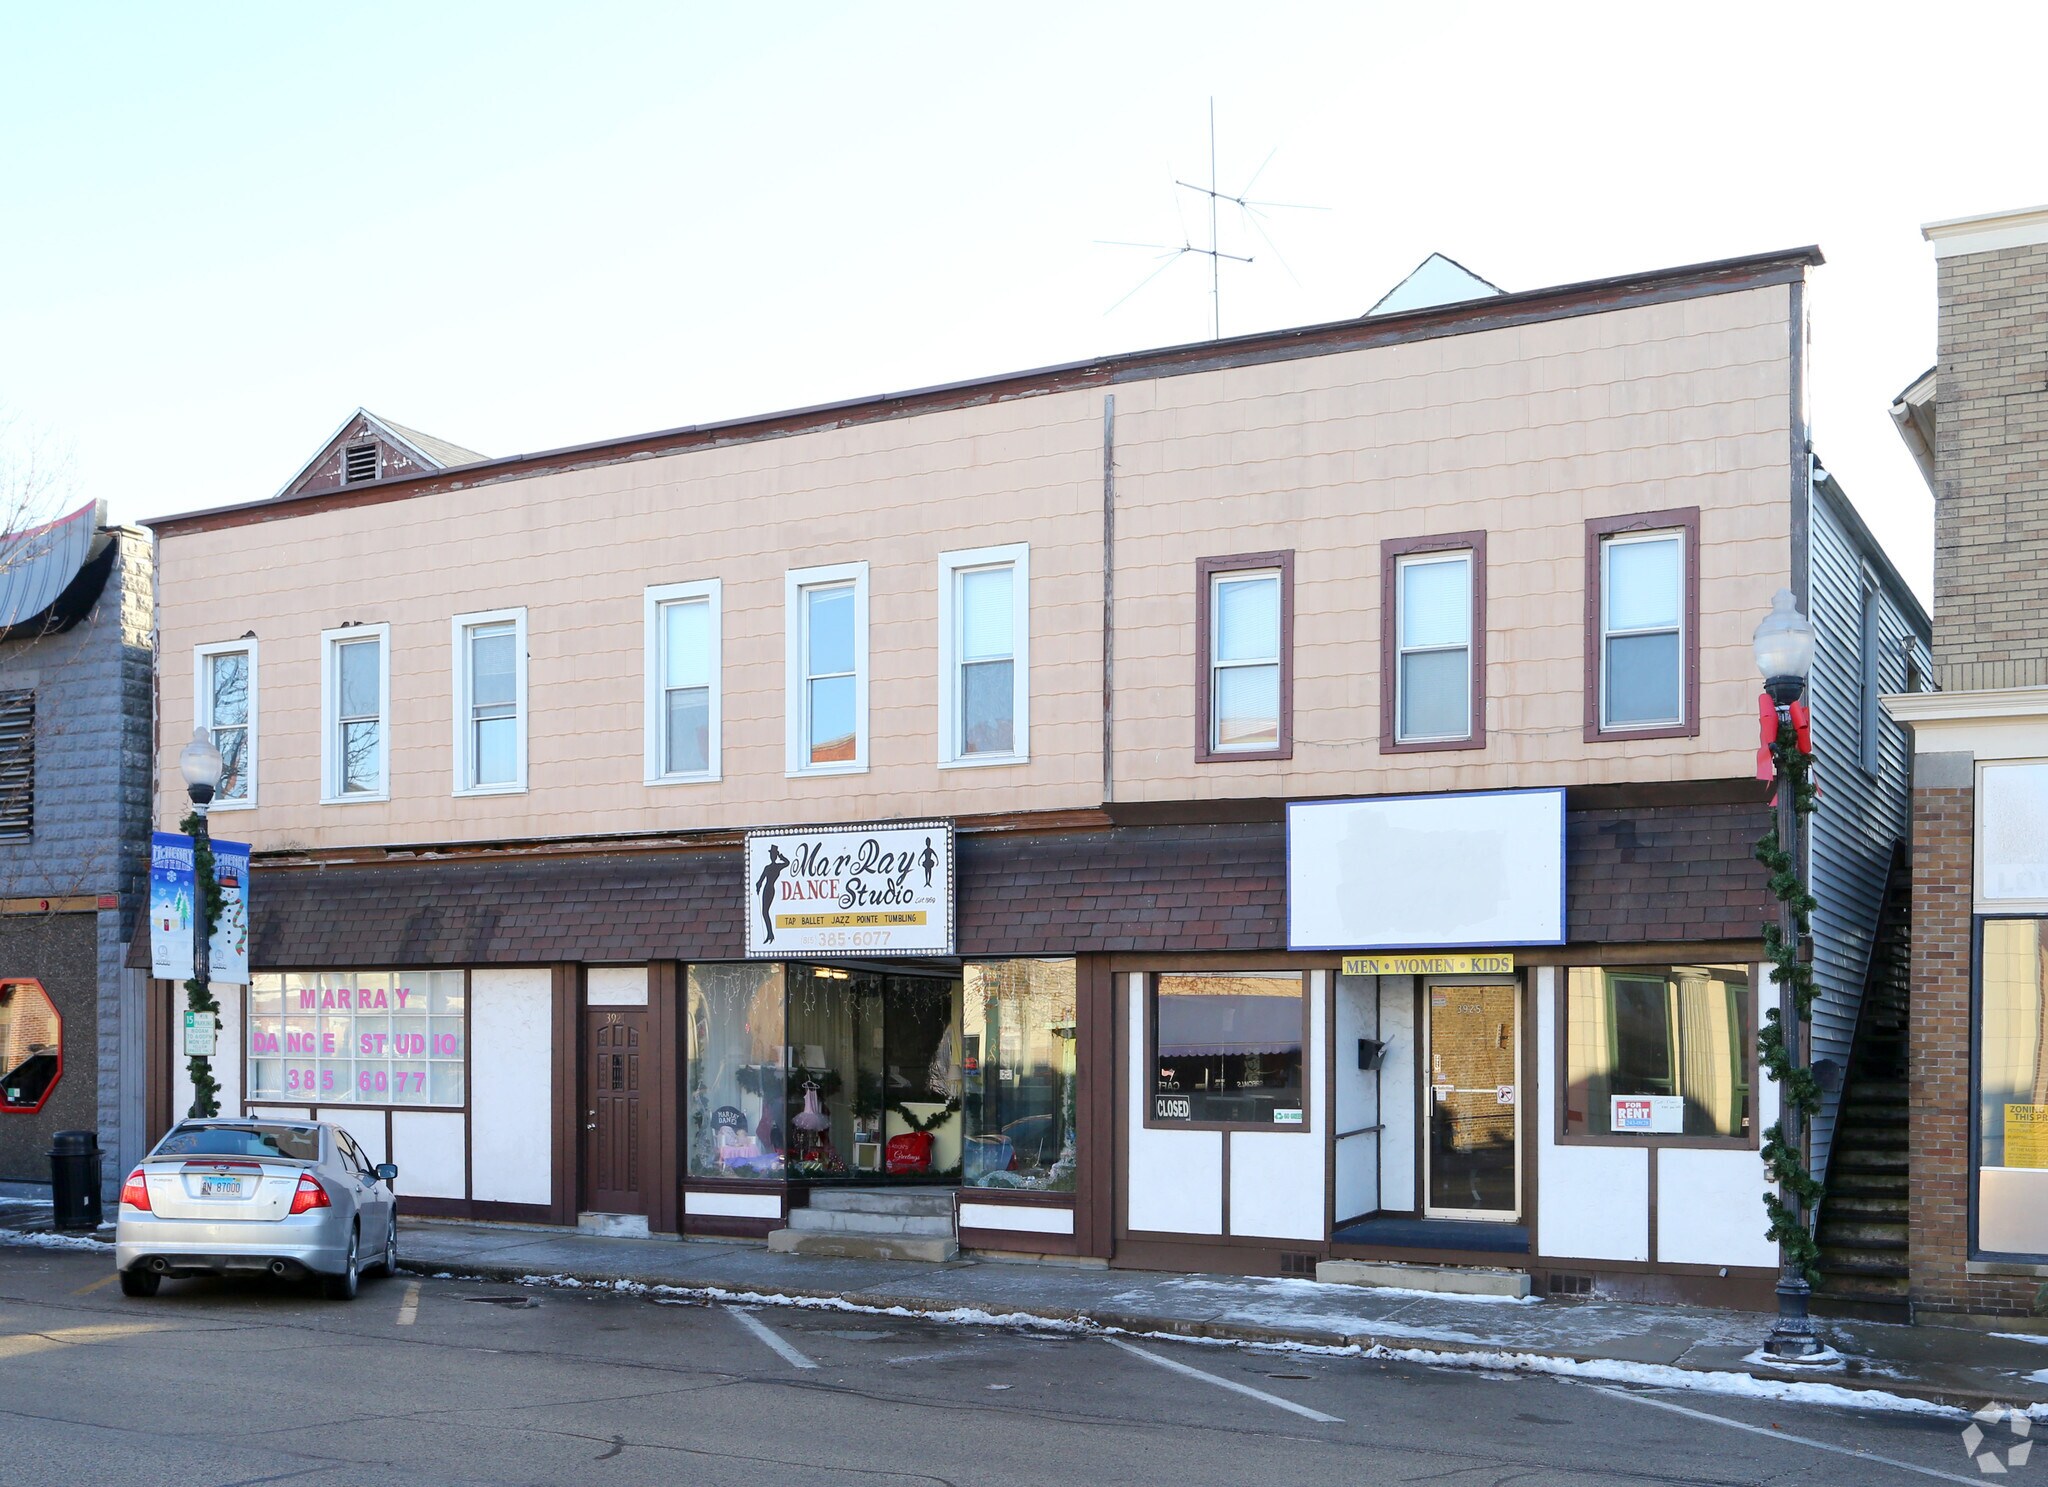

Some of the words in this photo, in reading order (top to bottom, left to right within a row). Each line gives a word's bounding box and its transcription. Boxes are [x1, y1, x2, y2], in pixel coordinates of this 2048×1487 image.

[780, 877, 842, 901] DANCE
[837, 877, 914, 910] Studio
[785, 917, 797, 926] TAP
[802, 916, 825, 925] BALLET
[831, 915, 850, 925] JAZZ
[856, 914, 879, 924] POINTE
[885, 914, 917, 923] TUMBLING
[800, 935, 817, 945] (815)
[1345, 960, 1379, 975] MEN
[1394, 959, 1456, 974] WOMEN
[1470, 957, 1510, 973] KIDS
[300, 988, 411, 1009] MARRAY
[1457, 1004, 1482, 1014] 3925
[186, 1015, 194, 1024] 15
[253, 1032, 335, 1053] DANCE
[360, 1033, 457, 1055] STUDIO
[287, 1069, 335, 1090] 385
[359, 1071, 426, 1093] 6077
[1157, 1099, 1189, 1118] CLOSED
[1618, 1108, 1650, 1119] RENT
[2009, 1105, 2045, 1114] ZONING
[2014, 1113, 2035, 1121] THIS
[216, 1182, 241, 1193] 87000
